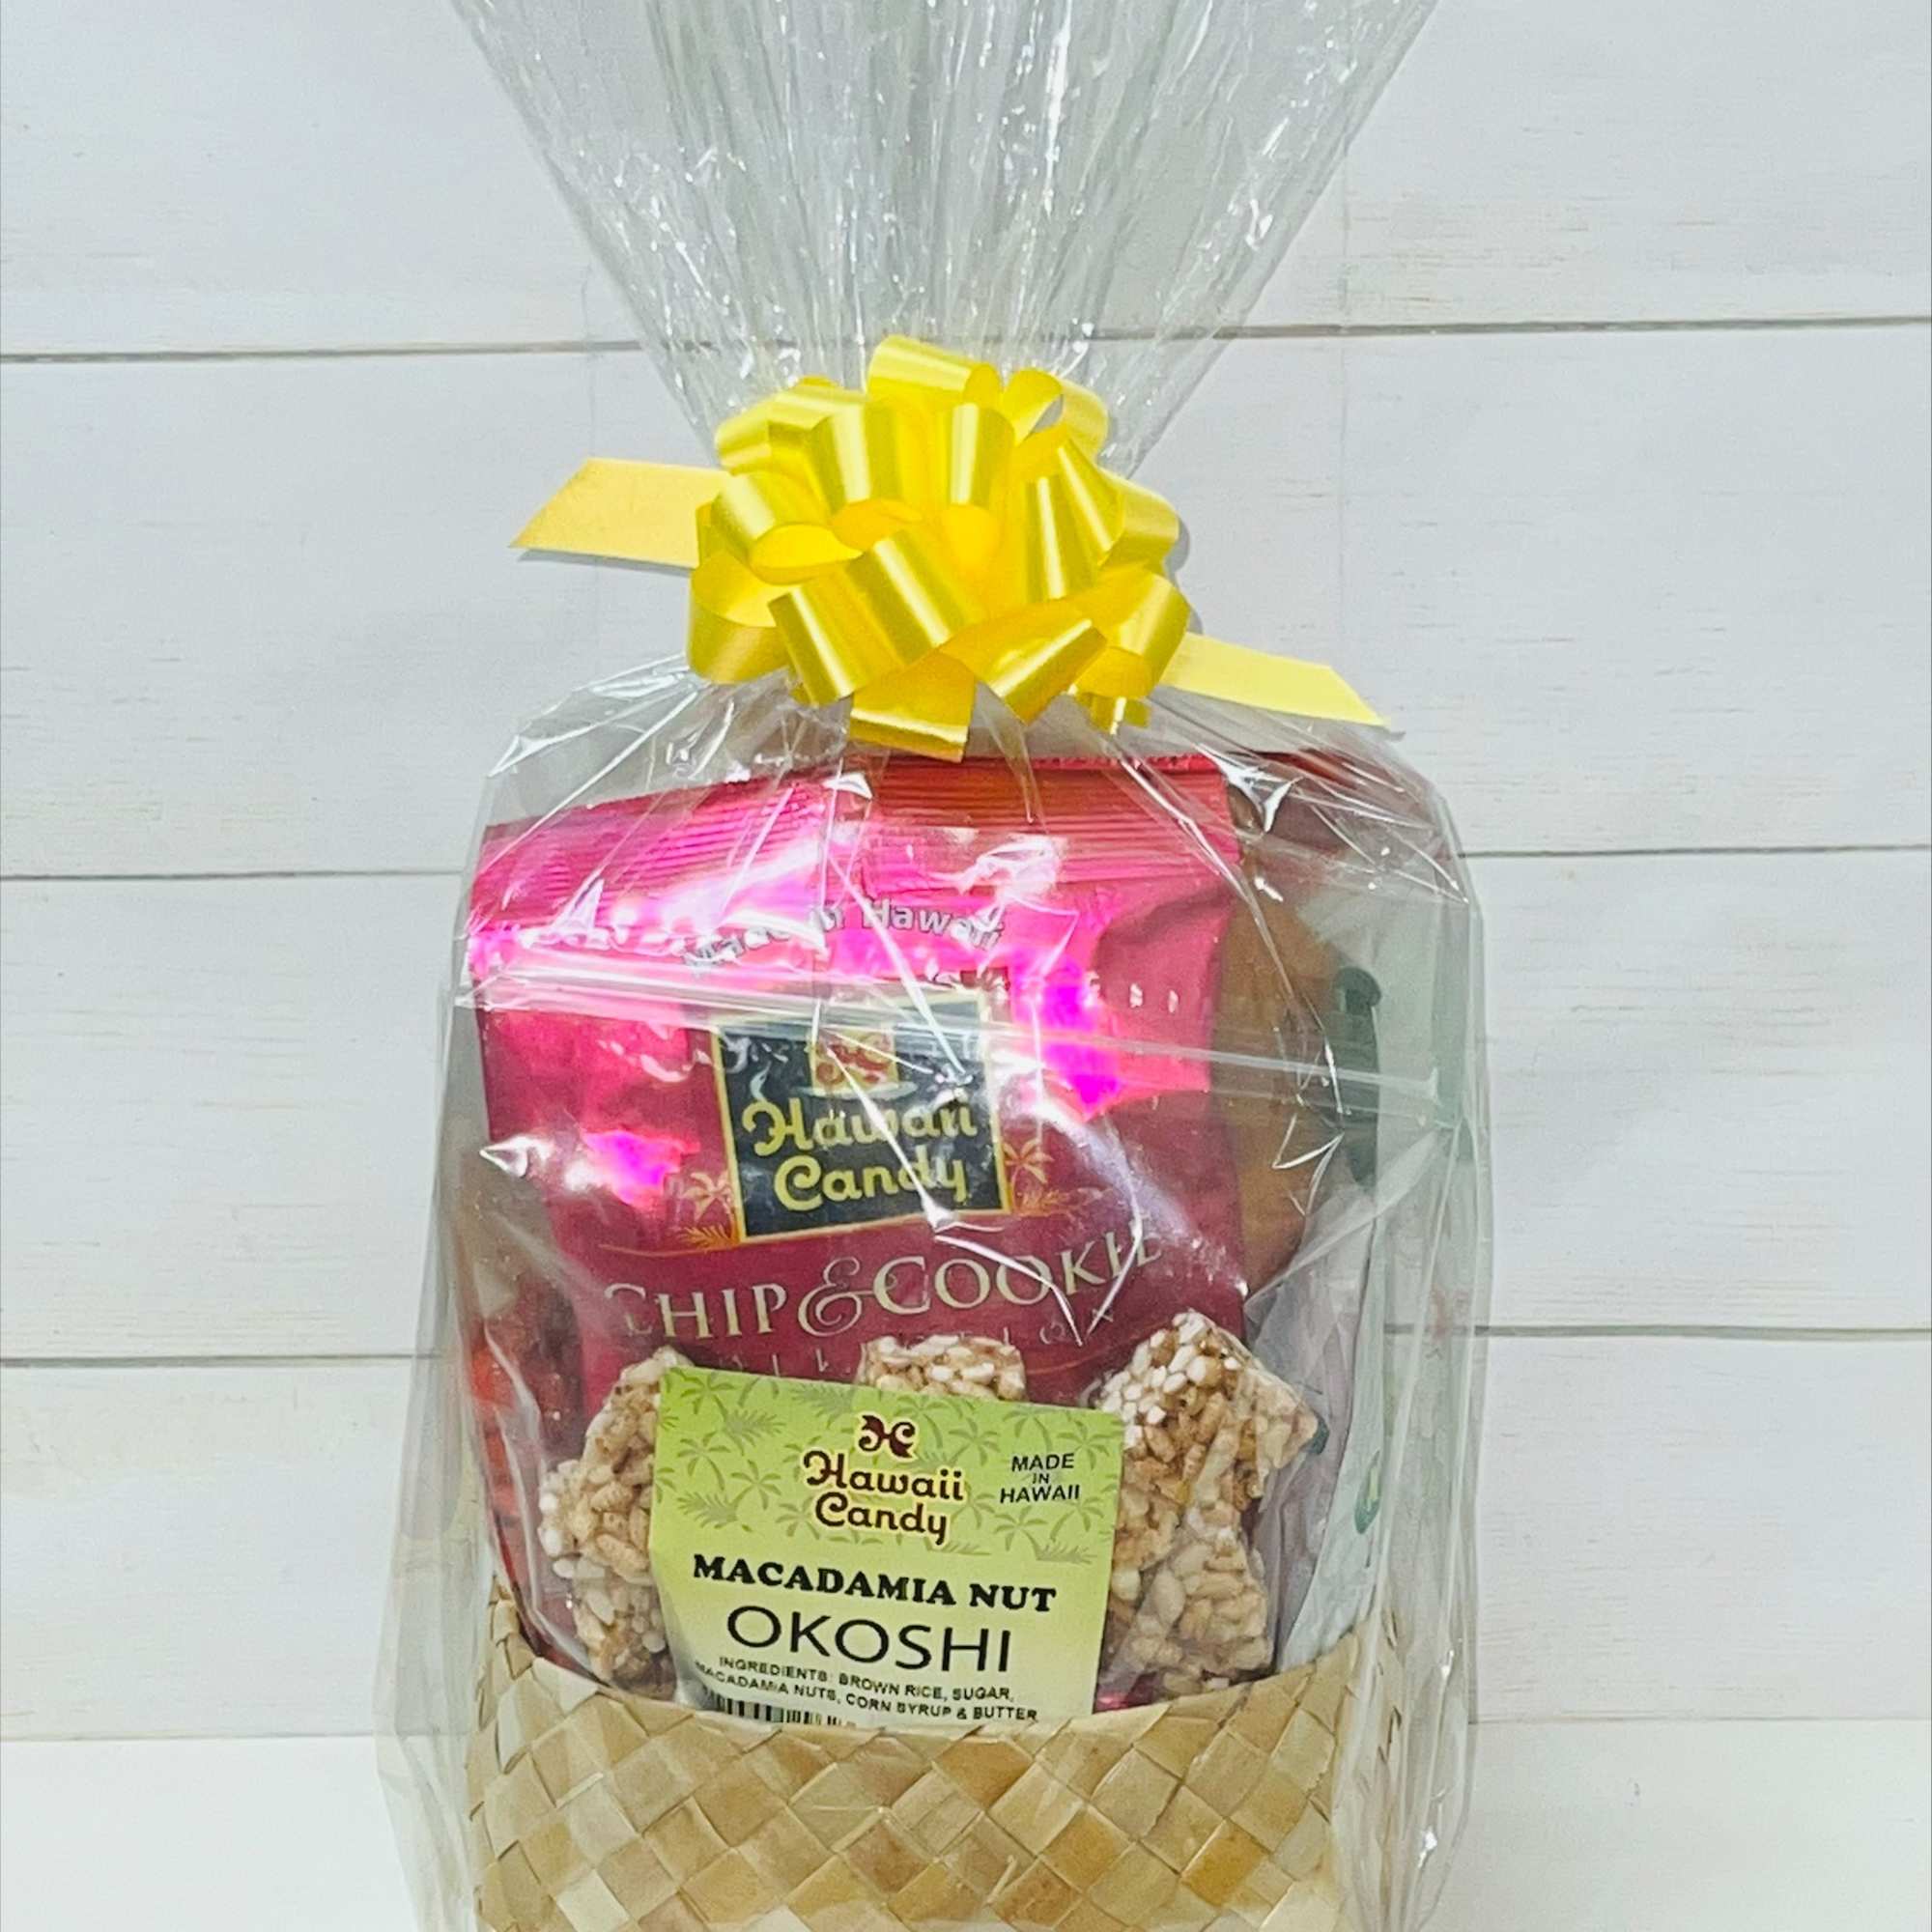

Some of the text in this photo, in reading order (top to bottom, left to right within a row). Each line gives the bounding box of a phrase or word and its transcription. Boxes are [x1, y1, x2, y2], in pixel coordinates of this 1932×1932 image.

[775, 1154, 969, 1212] Candy
[604, 1282, 788, 1339] CHIP
[796, 1257, 895, 1338] &
[803, 1450, 964, 1501] Hawaii
[1011, 1453, 1075, 1472] MADE
[1032, 1472, 1050, 1485] IN
[815, 1492, 948, 1546] Candy
[1000, 1484, 1080, 1504] HAWAII
[693, 1553, 1057, 1612] MACADAMIA NUT
[726, 1605, 1011, 1673] OKOSHI
[695, 1660, 789, 1695] MACADAMIA
[845, 1692, 892, 1713] CORN
[896, 1701, 952, 1718] SYRUP
[955, 1707, 967, 1720] &
[973, 1705, 1038, 1722] BUTTER
[838, 1672, 900, 1696] BROWN
[904, 1684, 948, 1702] RICE,
